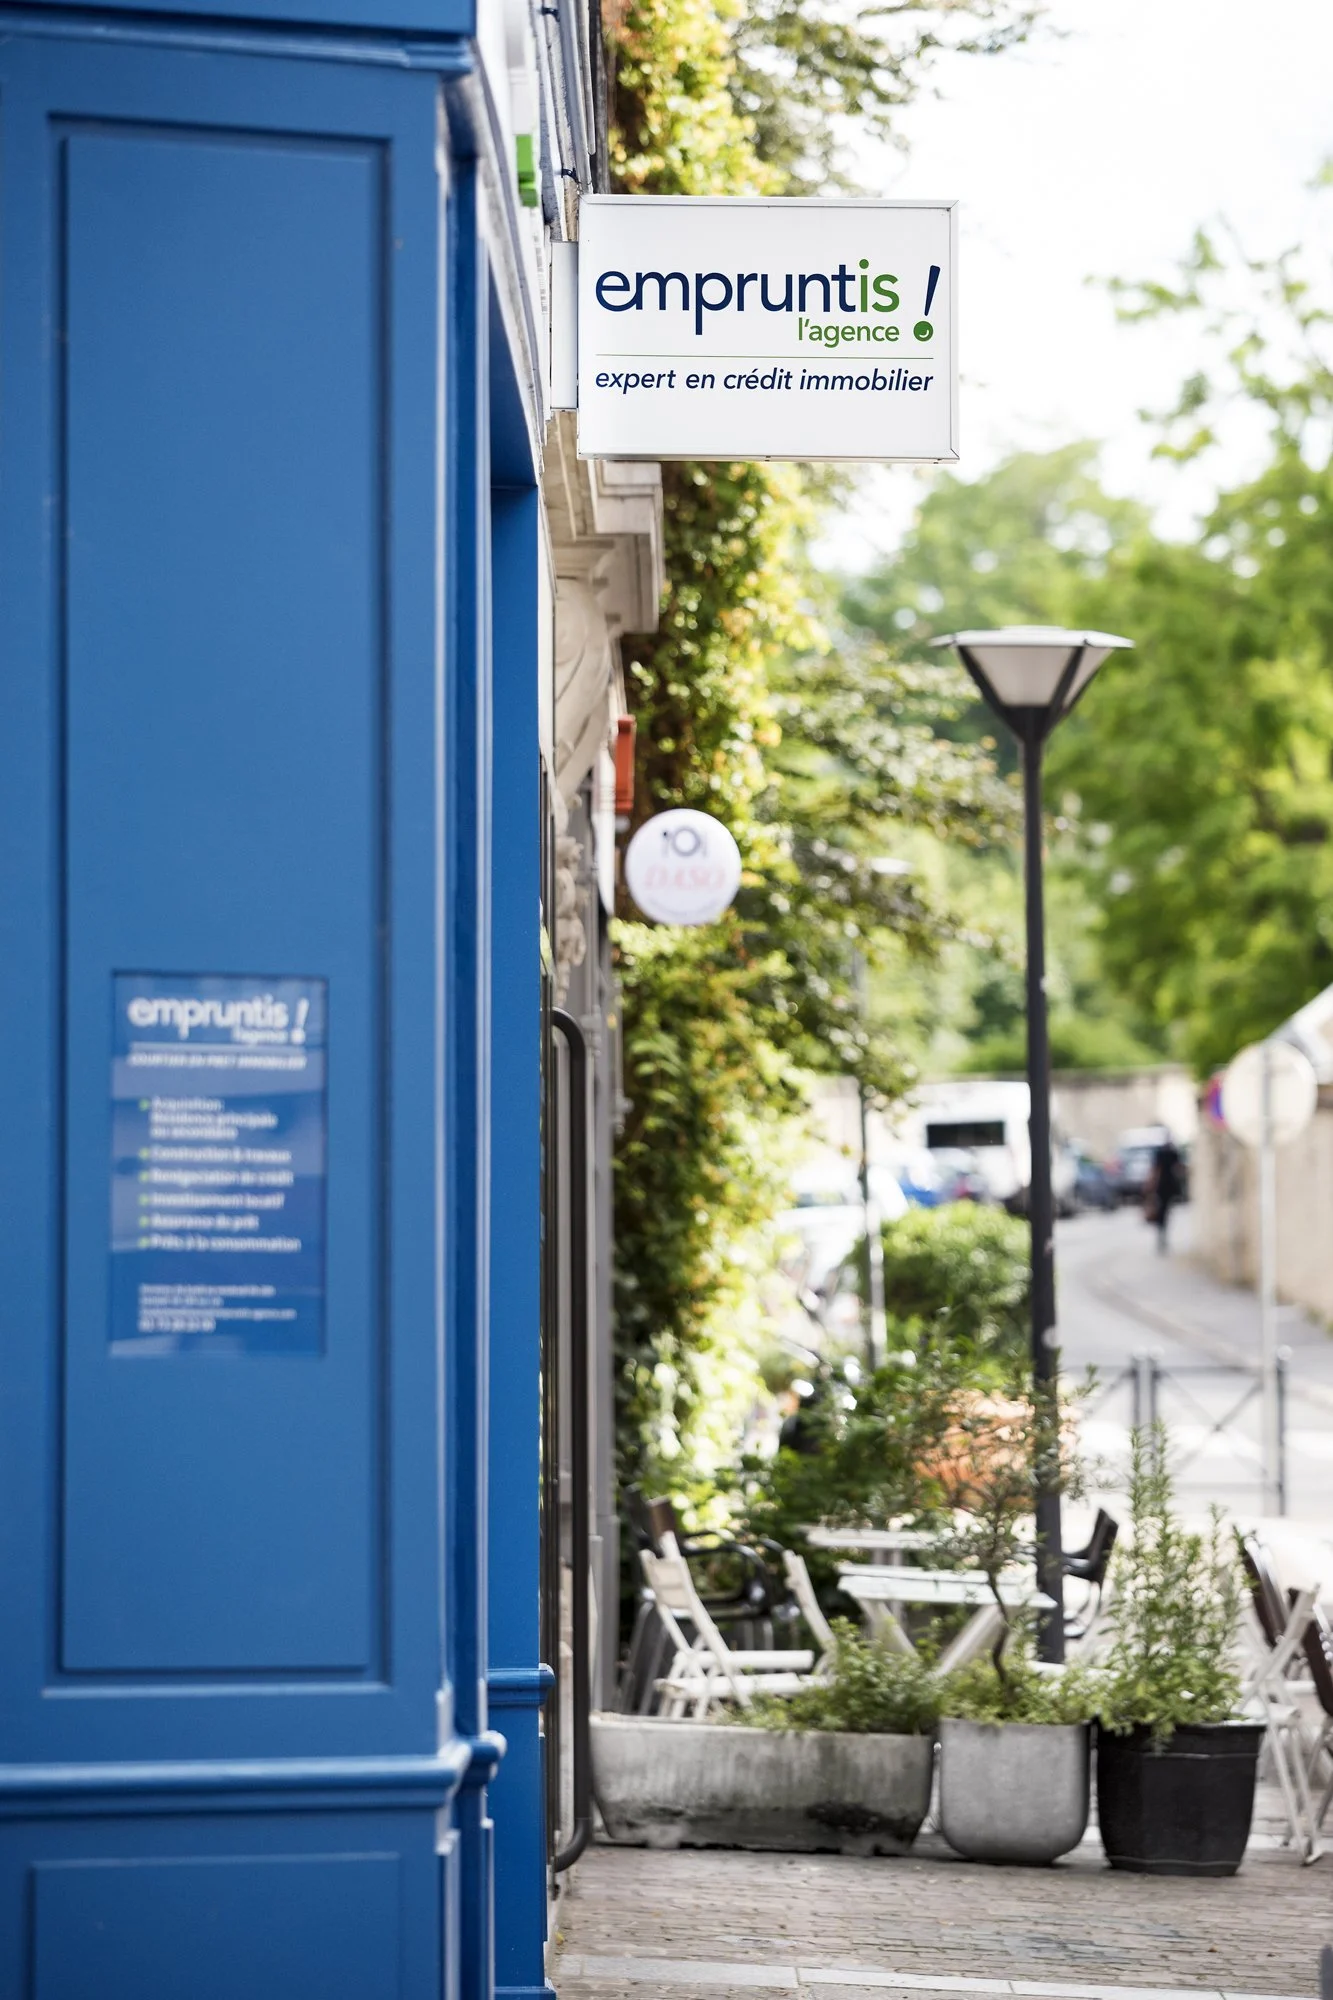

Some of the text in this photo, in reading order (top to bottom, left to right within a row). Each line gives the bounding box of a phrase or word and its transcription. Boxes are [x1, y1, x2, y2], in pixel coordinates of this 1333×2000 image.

[595, 259, 900, 335] empruntis
[798, 317, 900, 348] l'agence
[595, 368, 934, 394] expert en crédit immobilier
[128, 993, 288, 1039] empruntis
